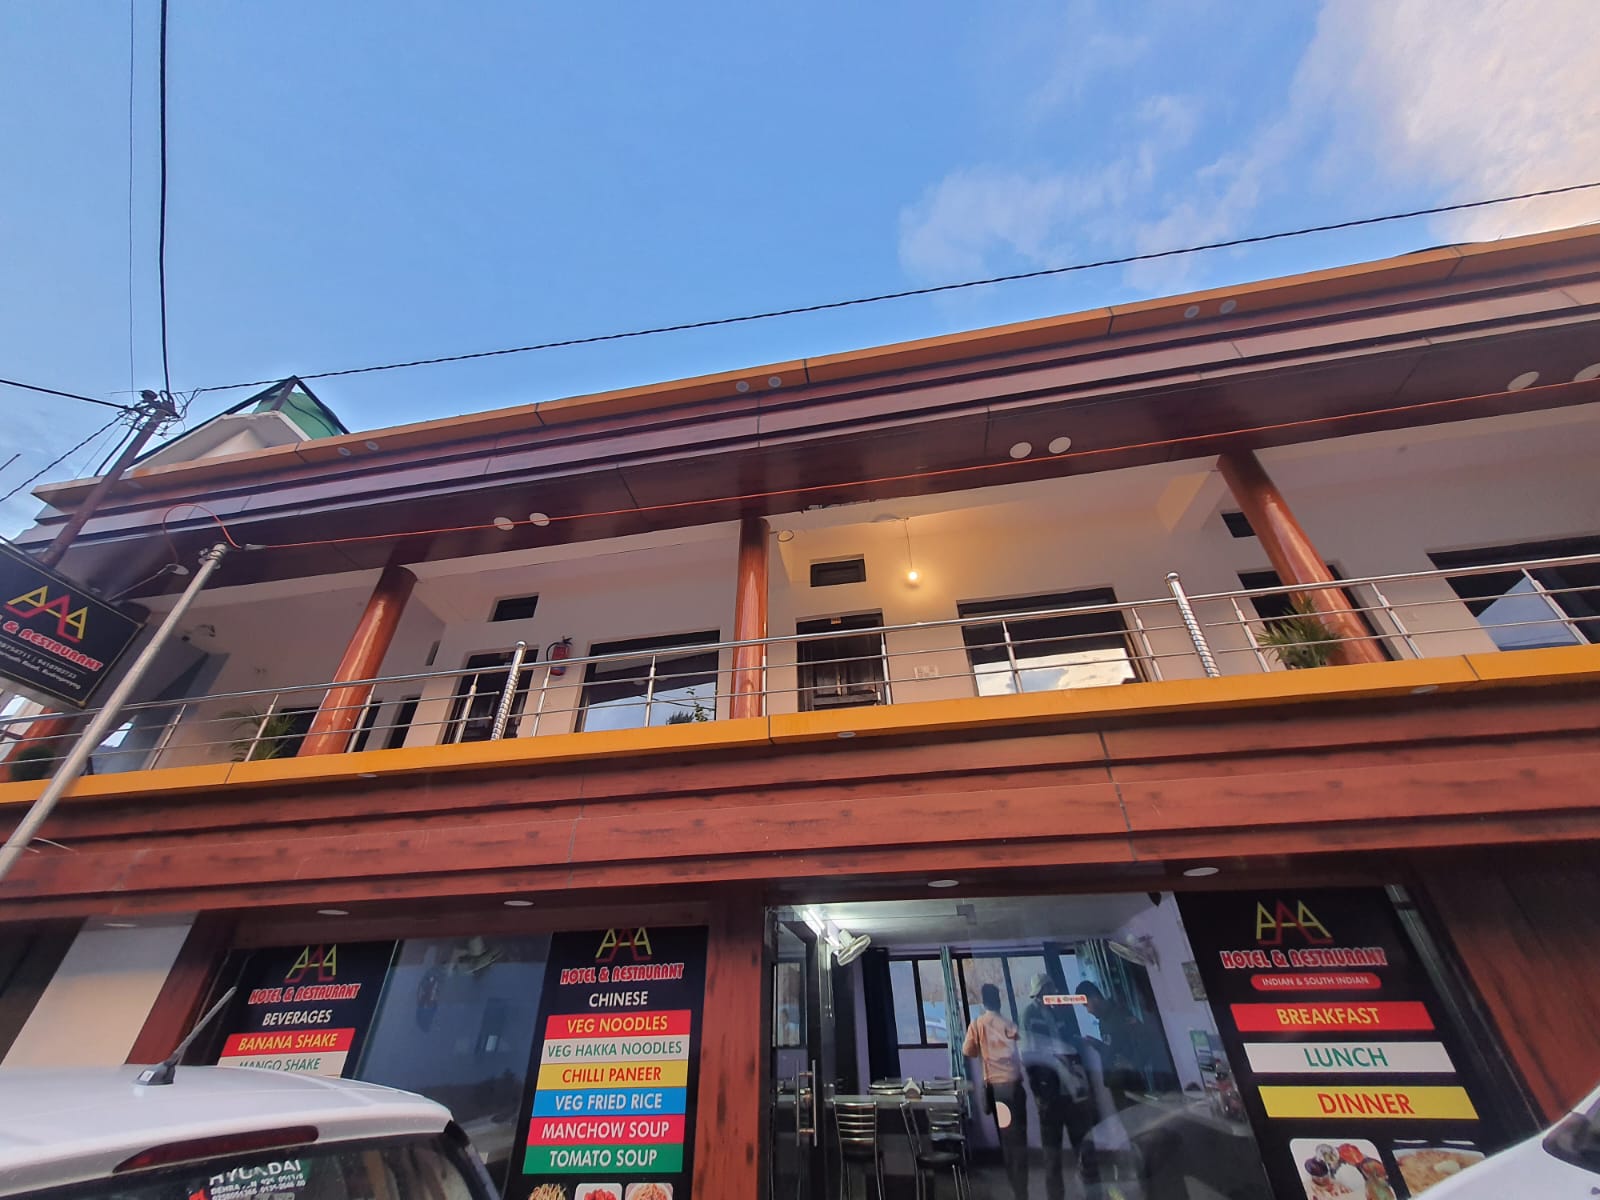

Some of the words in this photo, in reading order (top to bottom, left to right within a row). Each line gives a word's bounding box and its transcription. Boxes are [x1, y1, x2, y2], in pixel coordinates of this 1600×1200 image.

[3, 620, 19, 634] &
[18, 628, 104, 672] RESTAURANT
[1220, 949, 1272, 969] HOTEL
[1271, 949, 1290, 967] &
[1288, 947, 1388, 968] RESTAURANT
[560, 967, 597, 985] HOTEL
[598, 966, 609, 983] &
[612, 963, 684, 982] RESTAURANT
[1262, 978, 1295, 986] INDIAN
[1303, 976, 1335, 985] SOUTH
[1335, 975, 1370, 985] INDIAN
[247, 987, 283, 1005] HOTEL
[283, 986, 295, 1003] &
[294, 983, 361, 1003] RESTAURANT
[588, 991, 648, 1008] CHINESE
[262, 1009, 332, 1026] BEVERAGES
[567, 1018, 595, 1033] VEG
[599, 1015, 668, 1032] NOODLES
[1276, 1007, 1379, 1025] BREAKFAST
[238, 1034, 293, 1051] BANANA
[295, 1033, 338, 1048] SHAKE
[548, 1044, 572, 1058] VEG
[575, 1043, 618, 1057] HAKKA
[621, 1041, 682, 1055] NOODLES
[284, 1057, 321, 1071] SHAKE
[1303, 1047, 1389, 1068] LUNCH
[562, 1069, 605, 1083] CHILLI
[608, 1066, 662, 1082] PANEER
[555, 1095, 583, 1111] VEG
[587, 1094, 627, 1110] FRIED
[631, 1093, 663, 1109] RICE
[1317, 1093, 1416, 1115] DINNER
[541, 1122, 625, 1140] MANCHOW
[628, 1121, 670, 1138] SOUP
[549, 1150, 612, 1168] TOMATO
[615, 1149, 658, 1167] SOUP
